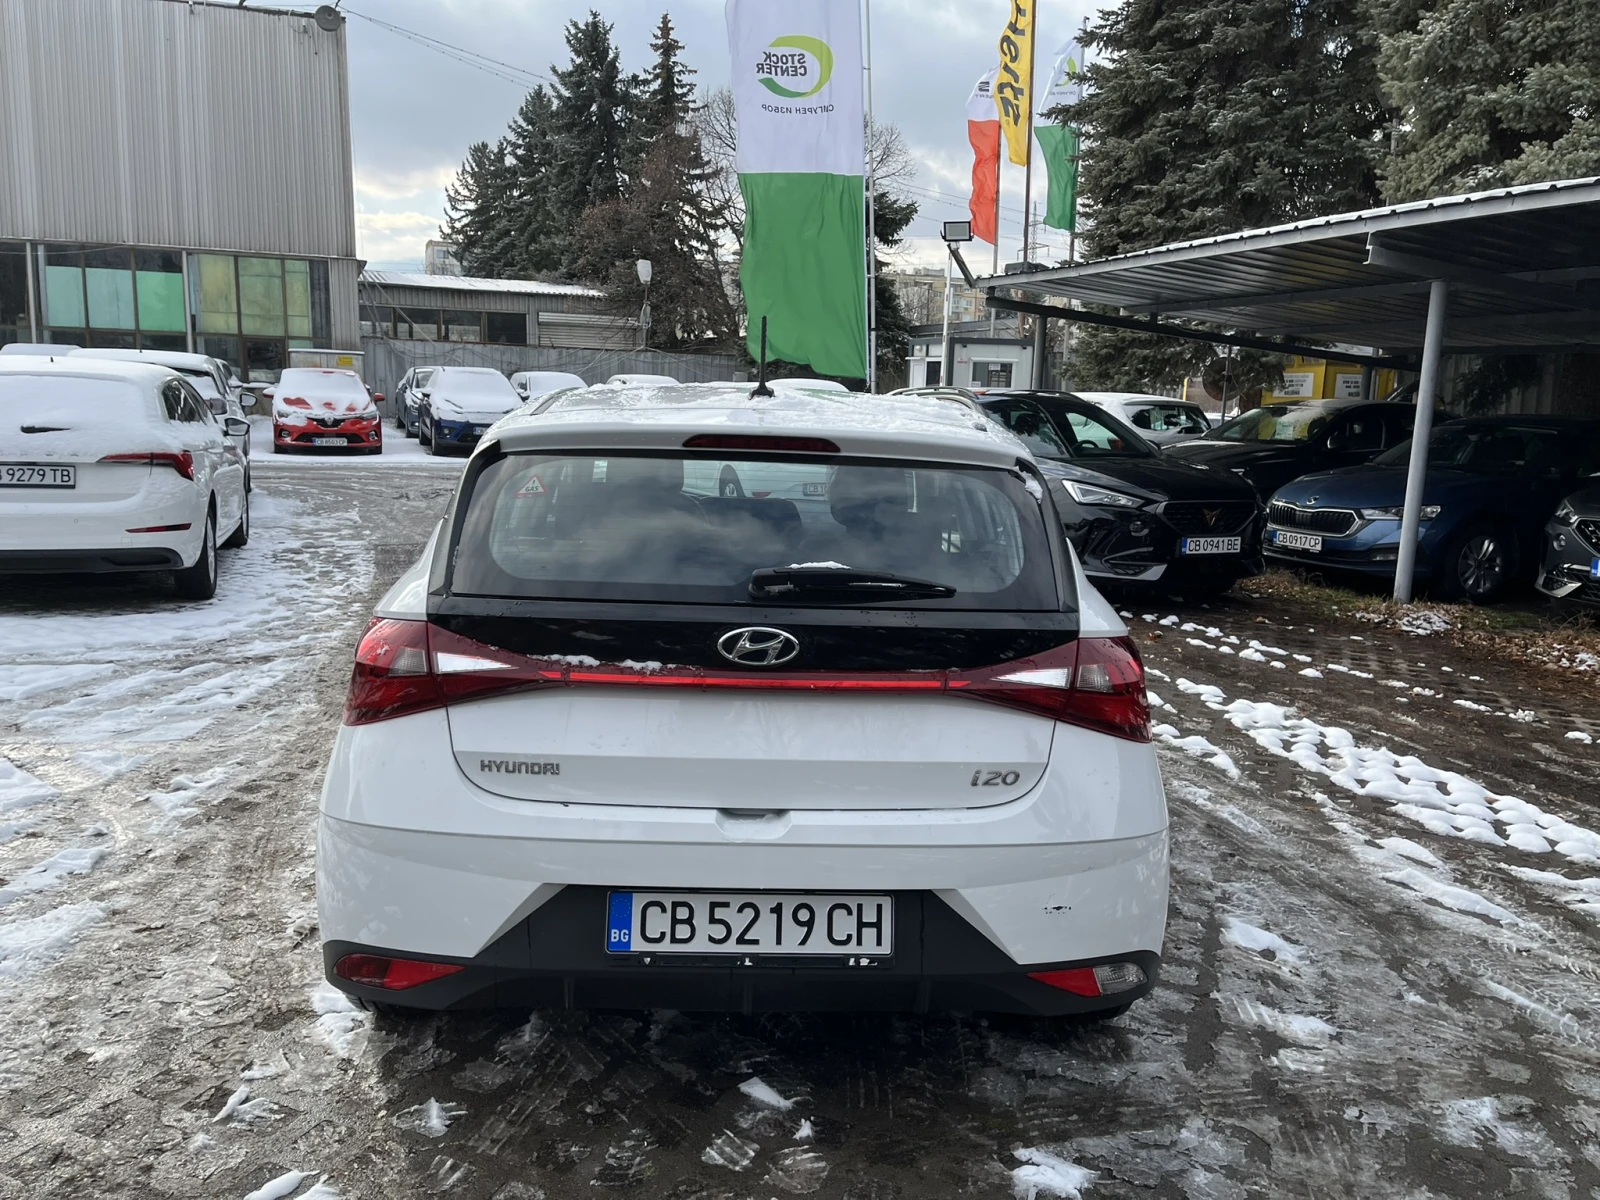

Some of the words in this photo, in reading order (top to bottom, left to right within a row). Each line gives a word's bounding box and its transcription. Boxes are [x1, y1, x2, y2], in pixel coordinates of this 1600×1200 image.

[997, 0, 1027, 127] Hertz
[6, 467, 46, 482] 9279
[50, 468, 71, 483] TB
[808, 485, 818, 493] CB
[1188, 540, 1200, 552] CB
[1202, 539, 1226, 551] 0941
[1227, 539, 1239, 551] BE
[1277, 532, 1288, 544] CB
[1288, 533, 1308, 546] 0917
[1308, 536, 1321, 548] CP
[480, 759, 560, 775] HYUNDAI
[970, 769, 1020, 787] i20
[639, 900, 696, 944] CB
[707, 901, 816, 946] 5219
[826, 902, 883, 947] CH
[610, 929, 629, 943] BG
